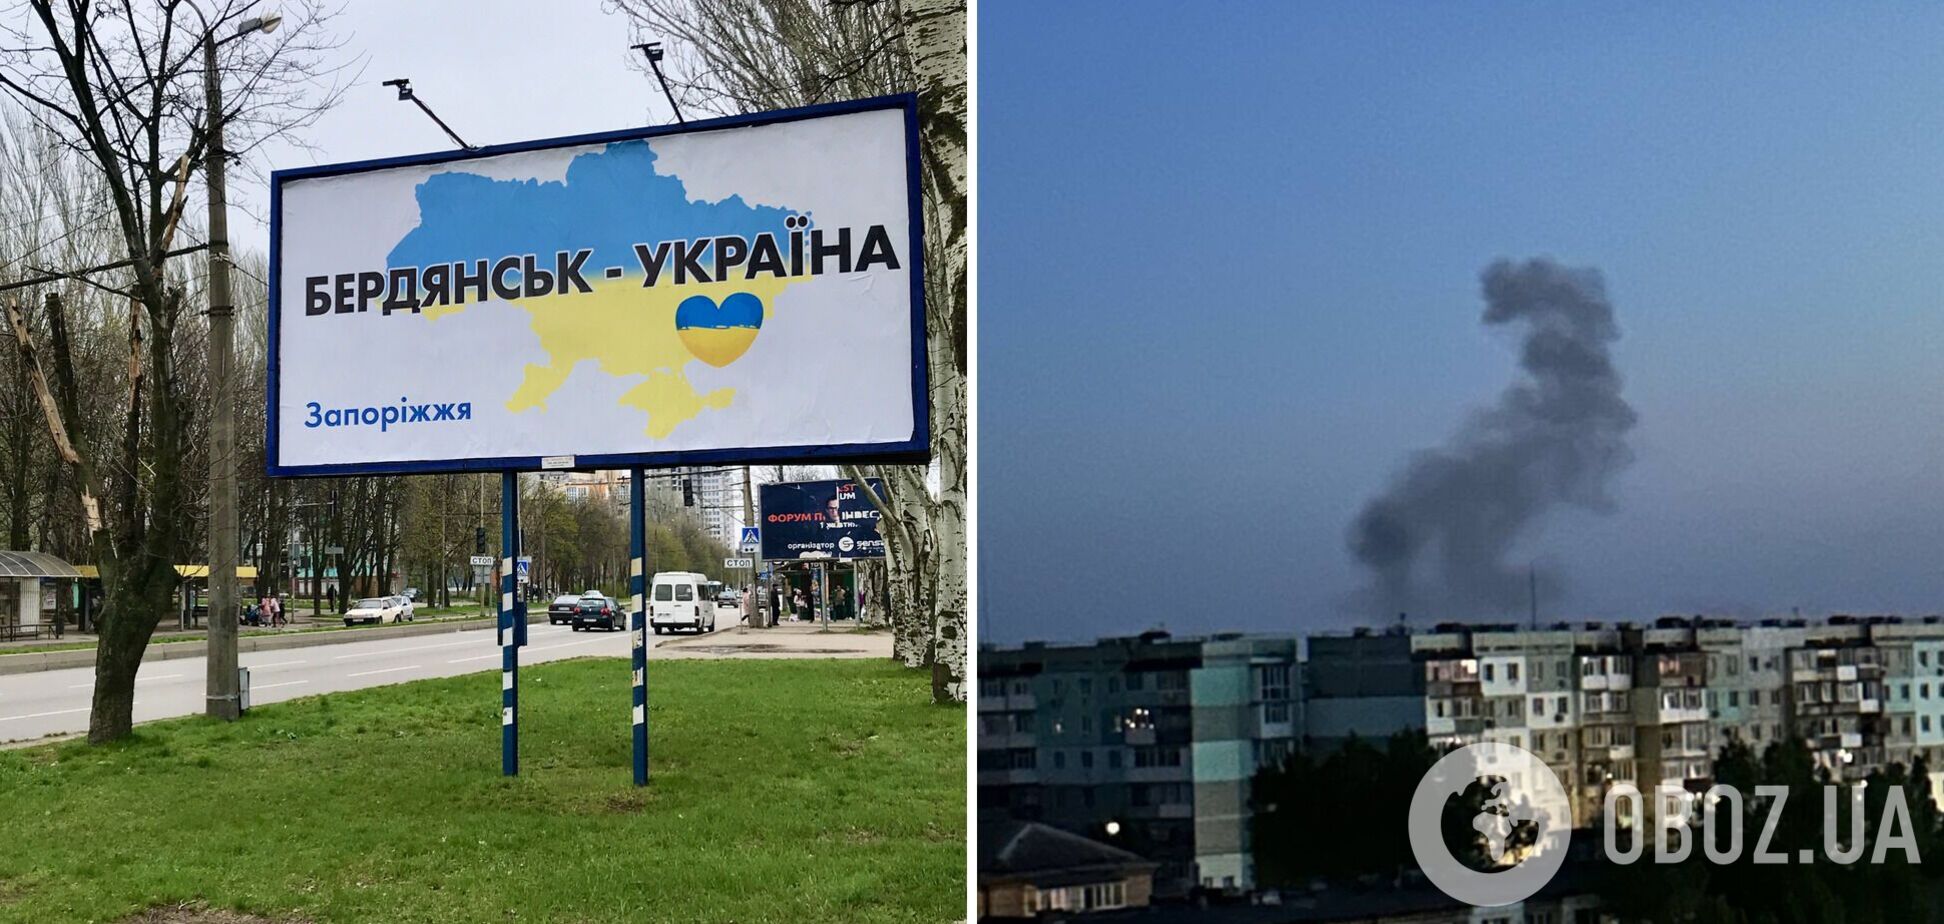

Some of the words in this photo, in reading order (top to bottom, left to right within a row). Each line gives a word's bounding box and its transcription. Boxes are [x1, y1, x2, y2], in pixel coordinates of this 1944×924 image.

[305, 250, 593, 316] БЕРДЯНСЬК
[606, 268, 622, 278] -
[634, 215, 901, 288] УКРАЇНА
[304, 397, 471, 432] Запоріжжя
[768, 513, 811, 522] ФОРУМ
[787, 541, 835, 550] організатор
